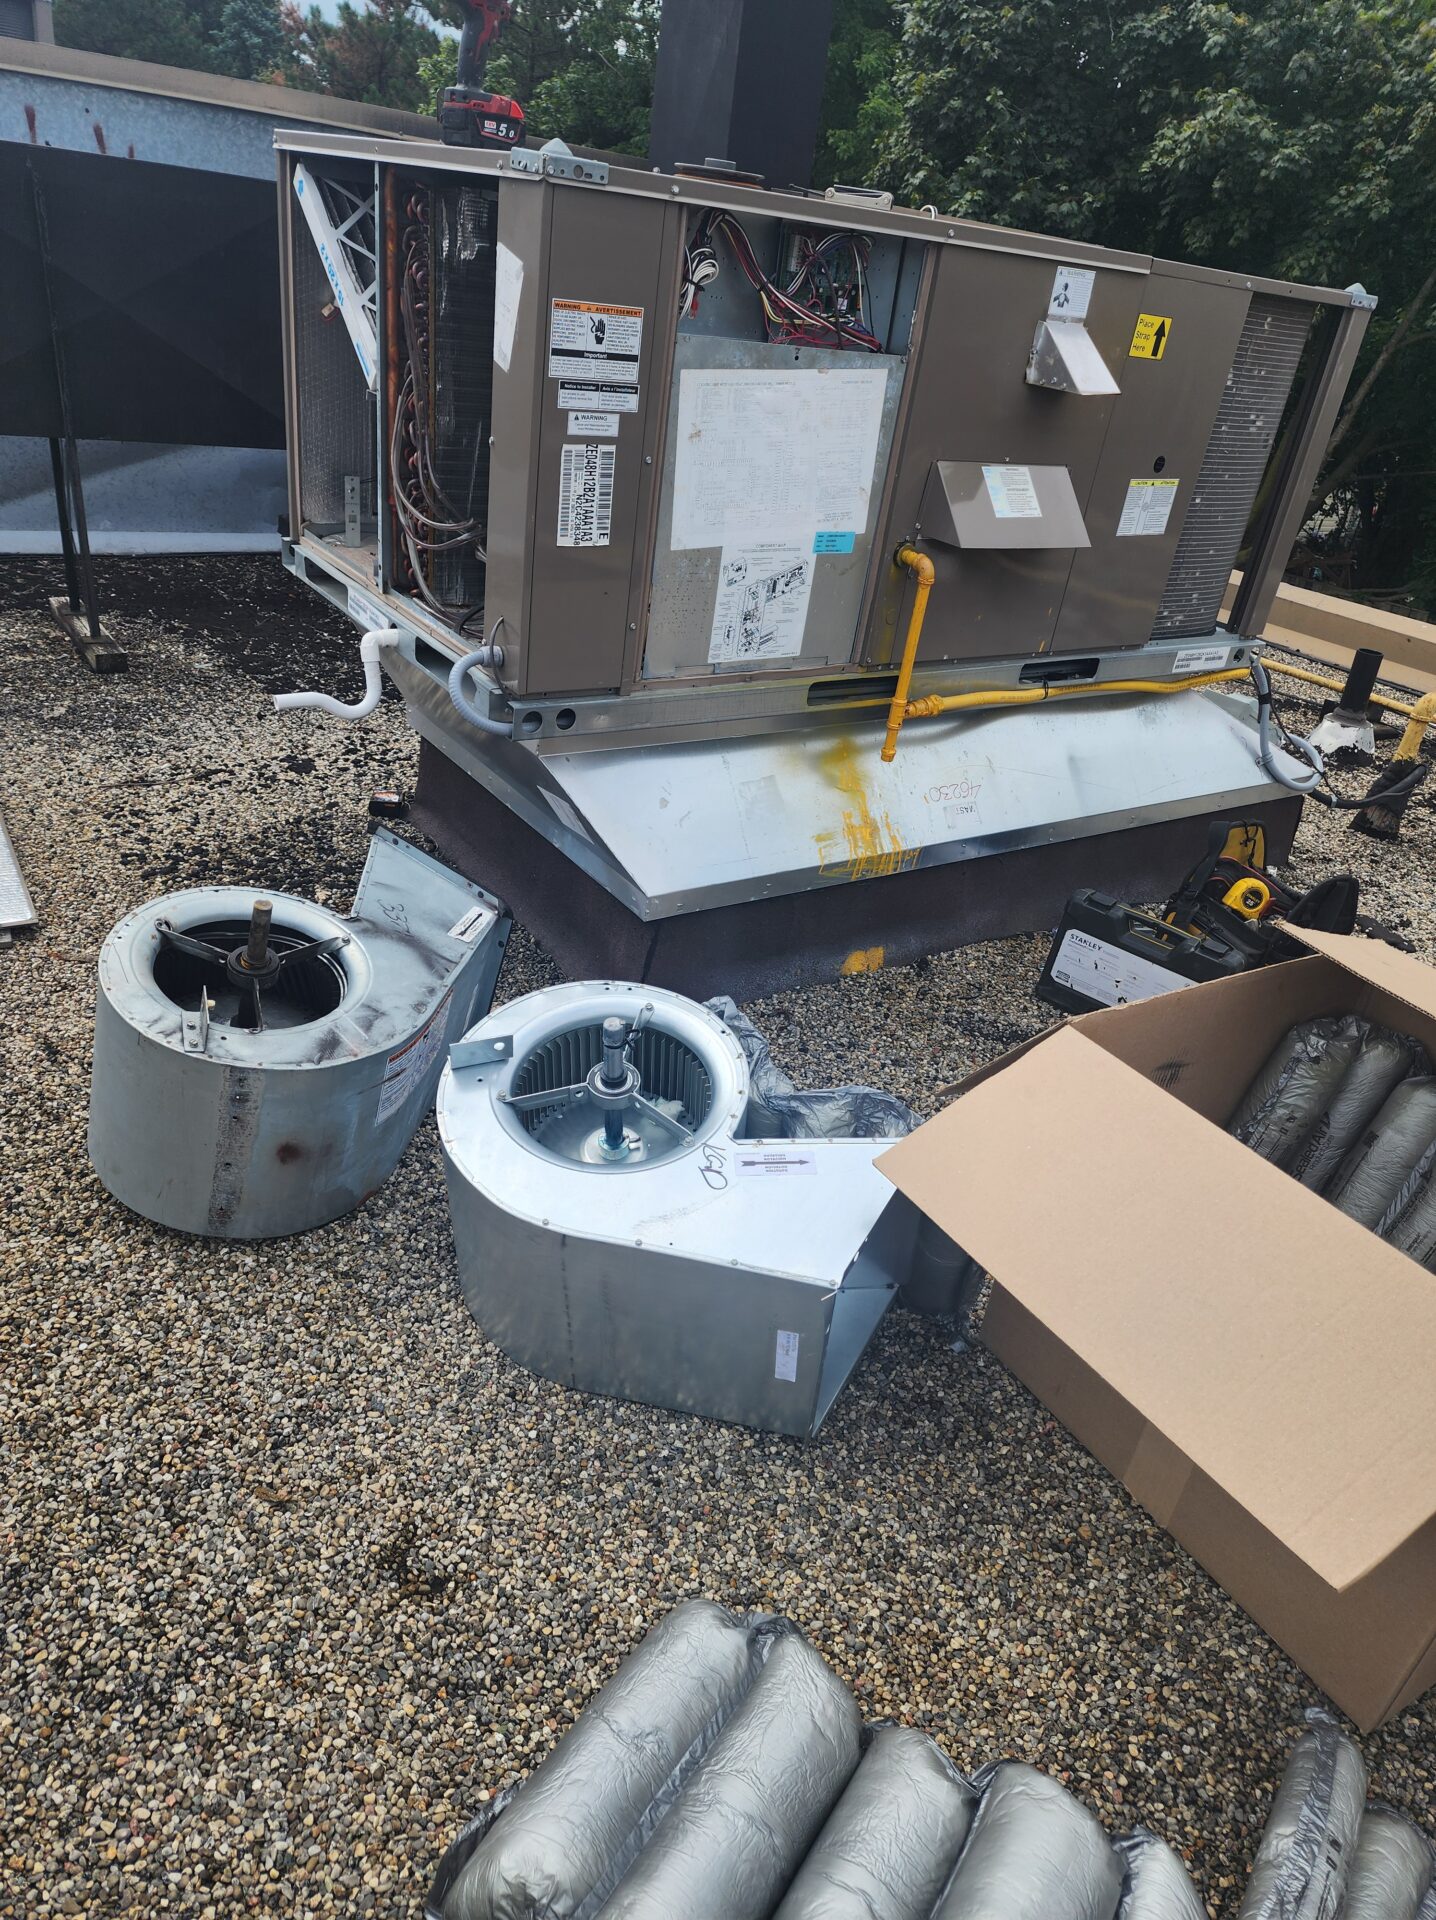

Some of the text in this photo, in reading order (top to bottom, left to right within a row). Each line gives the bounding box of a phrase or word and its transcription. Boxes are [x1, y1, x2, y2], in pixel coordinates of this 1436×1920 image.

[554, 302, 641, 317] WARNING AVERTISSEMENT
[1139, 318, 1154, 328] Place
[1135, 331, 1151, 342] Strap
[1132, 343, 1146, 352] Here
[583, 352, 608, 360] Important
[599, 532, 609, 540] E
[1070, 933, 1103, 951] STANLEY
[1293, 1126, 1326, 1181] Sealed Air
